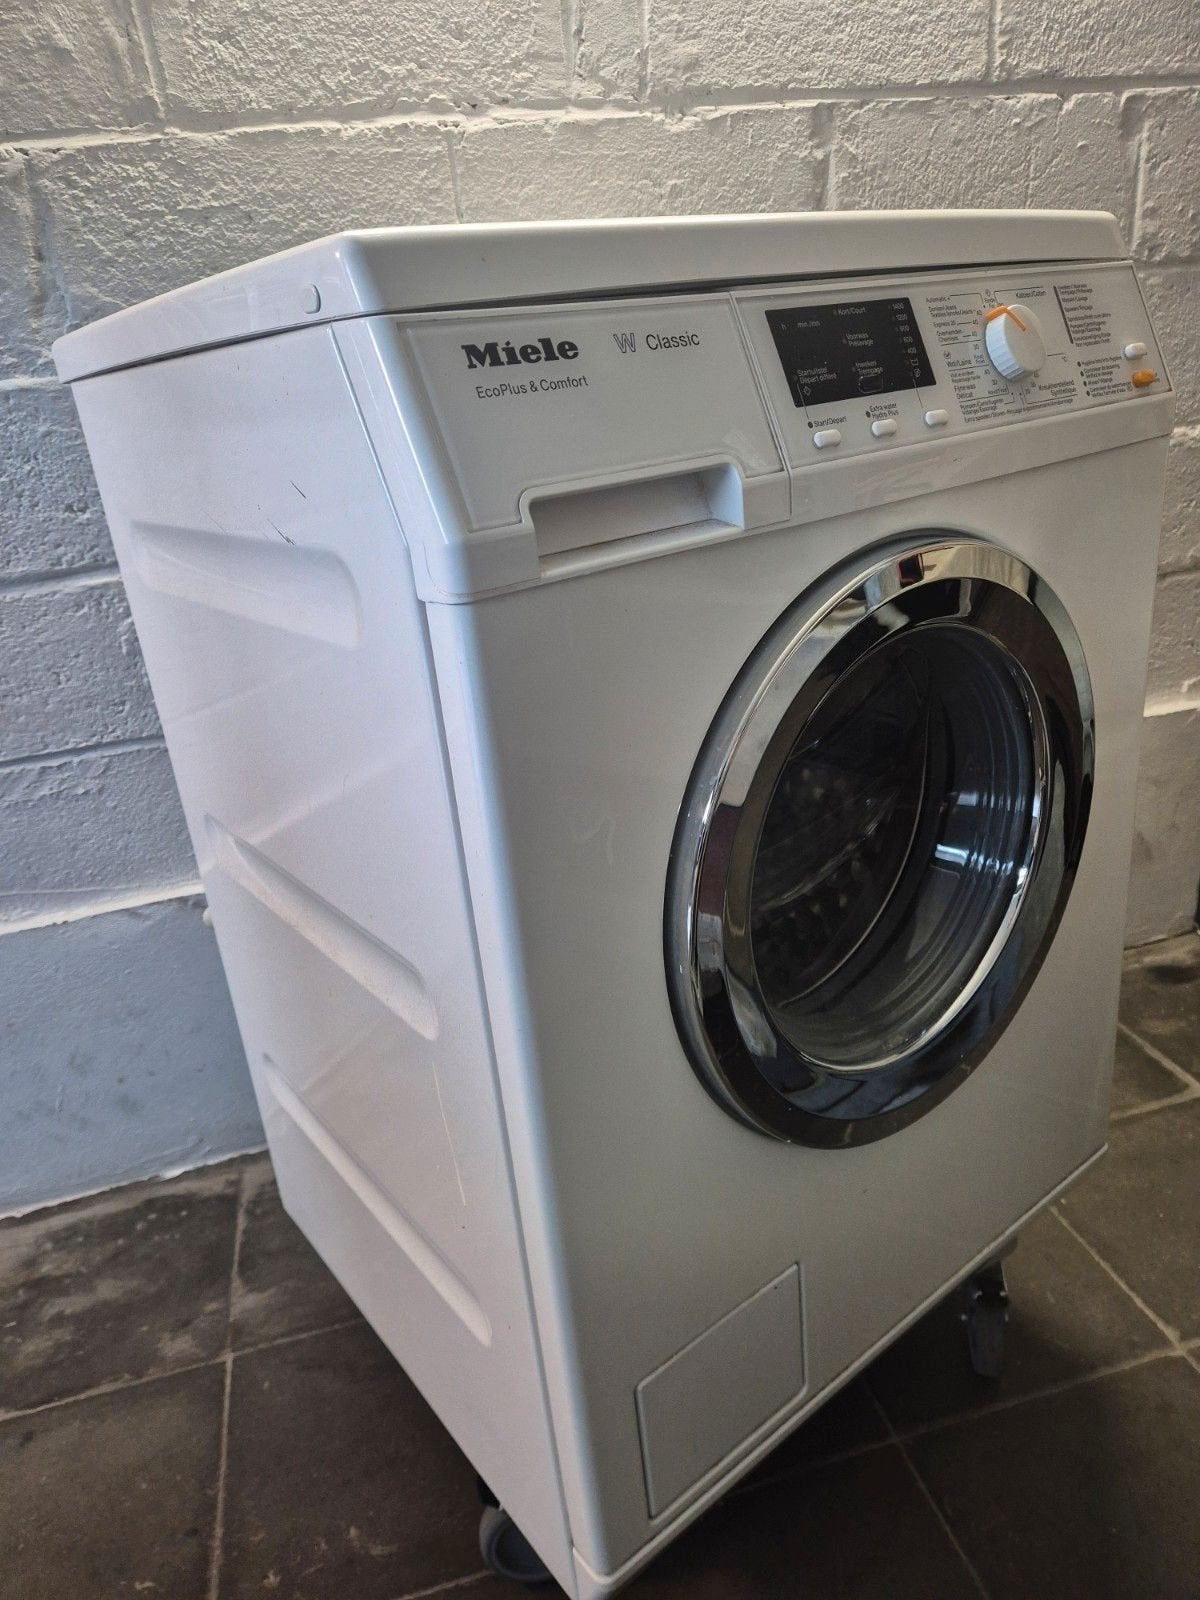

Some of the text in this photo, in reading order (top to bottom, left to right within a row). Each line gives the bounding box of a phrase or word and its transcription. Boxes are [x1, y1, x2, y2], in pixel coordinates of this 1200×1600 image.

[461, 338, 579, 369] Miele
[613, 331, 700, 354] W Classic
[475, 374, 589, 399] EcoPlus & Comfort
